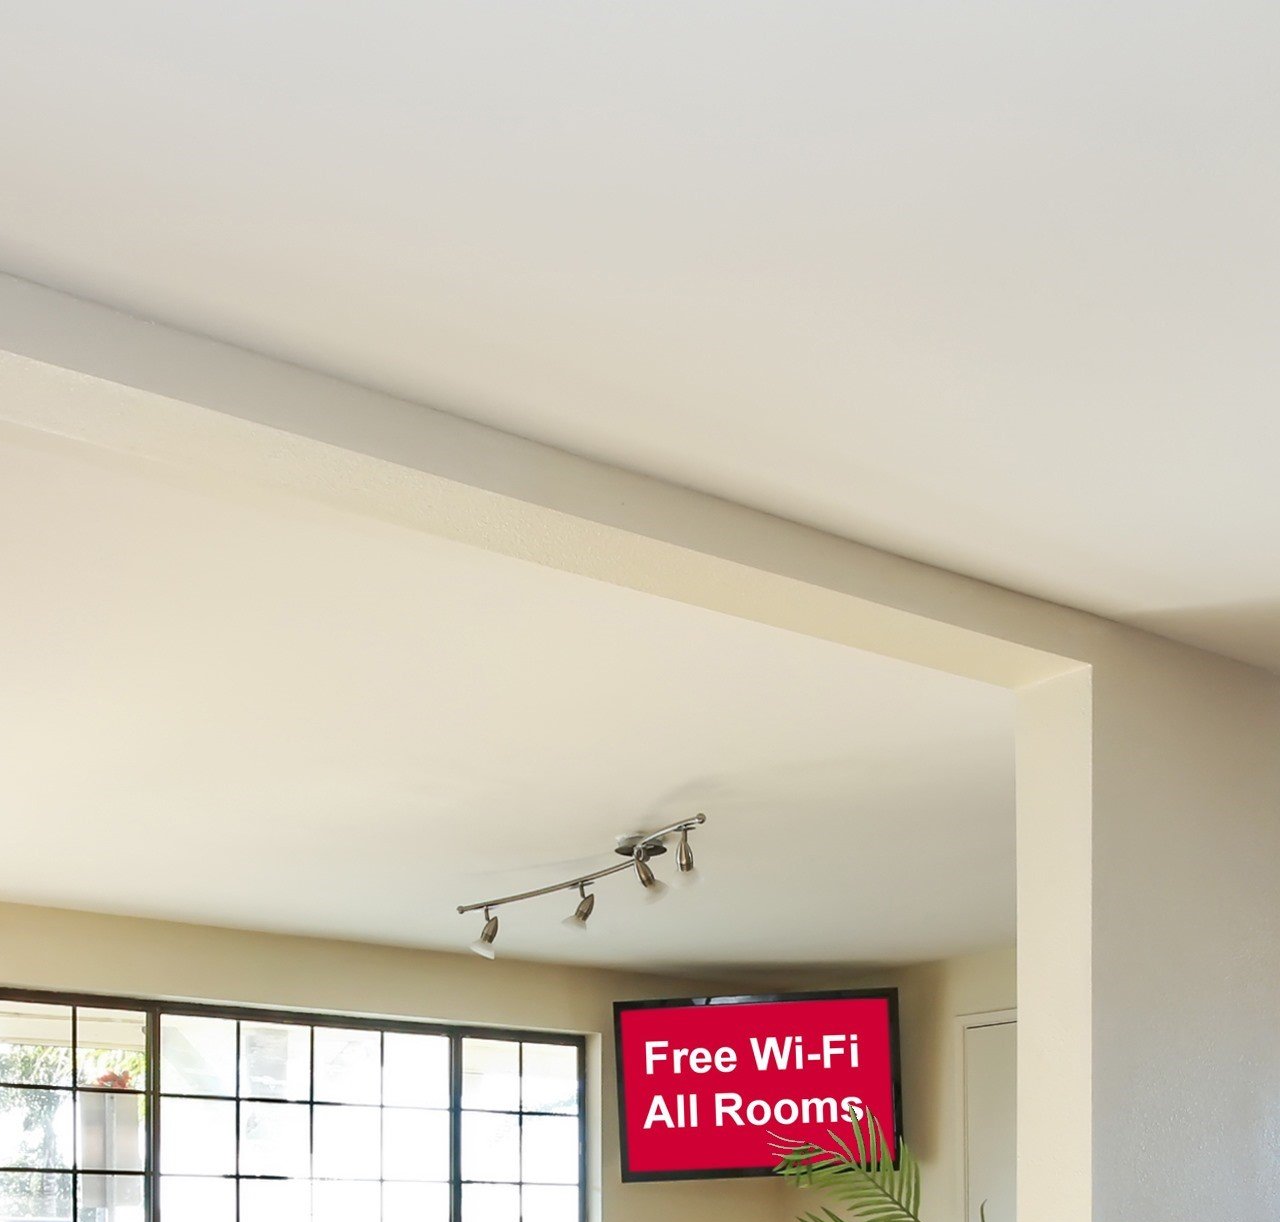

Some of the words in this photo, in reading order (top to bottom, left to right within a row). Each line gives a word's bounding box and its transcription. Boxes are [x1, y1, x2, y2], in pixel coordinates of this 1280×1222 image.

[644, 1040, 737, 1075] Free
[750, 1033, 859, 1071] Wi-Fi
[643, 1094, 698, 1130] All
[715, 1092, 864, 1127] Rooms
